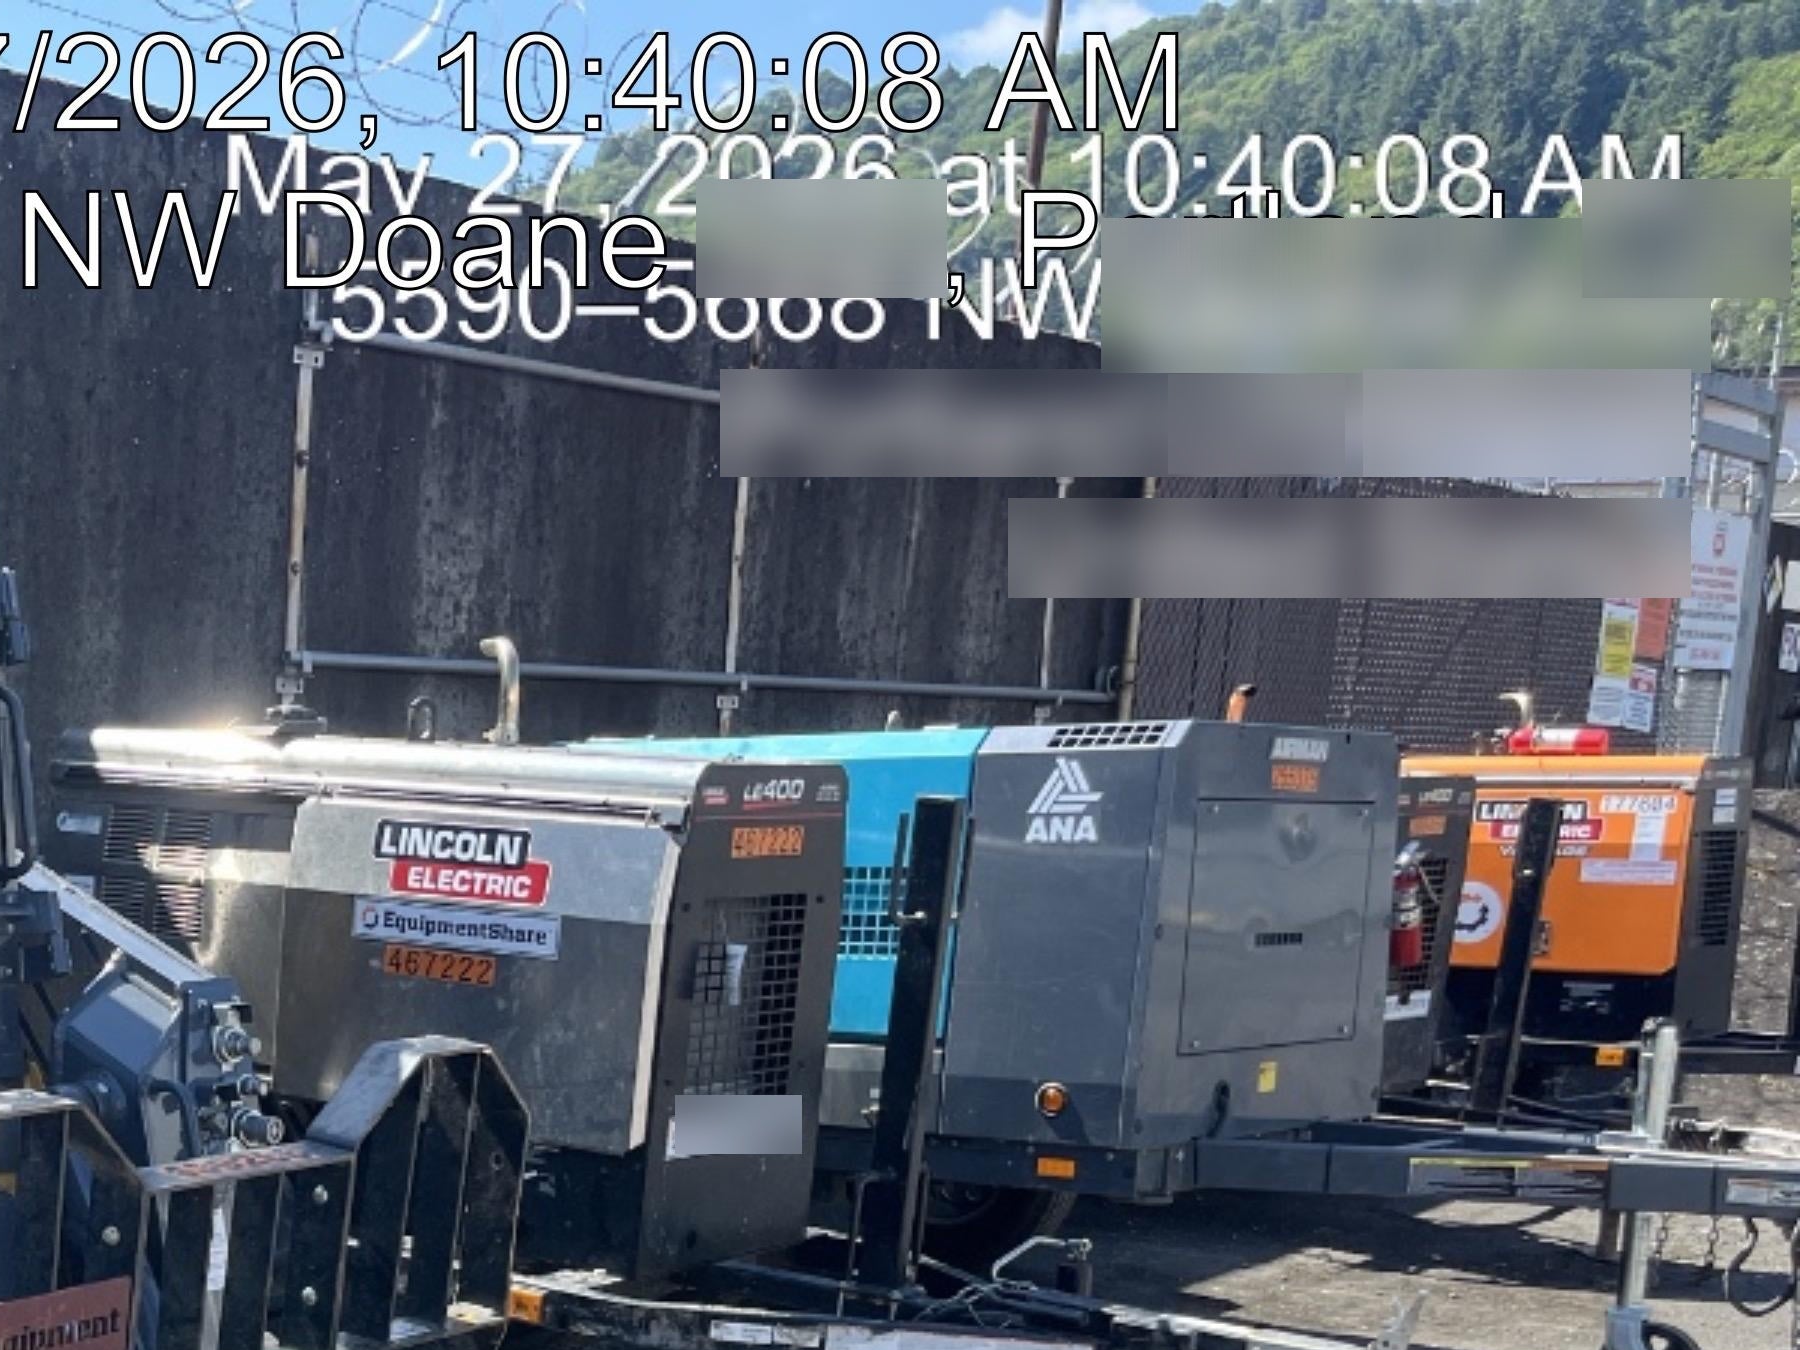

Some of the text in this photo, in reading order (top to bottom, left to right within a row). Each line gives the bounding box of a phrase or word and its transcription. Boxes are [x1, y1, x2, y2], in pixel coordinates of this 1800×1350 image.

[379, 823, 524, 866] LINCOLN
[1024, 815, 1099, 844] ANA
[406, 865, 533, 899] ELECTRIC
[382, 910, 548, 946] EquipmentShare
[387, 948, 494, 986] 467222
